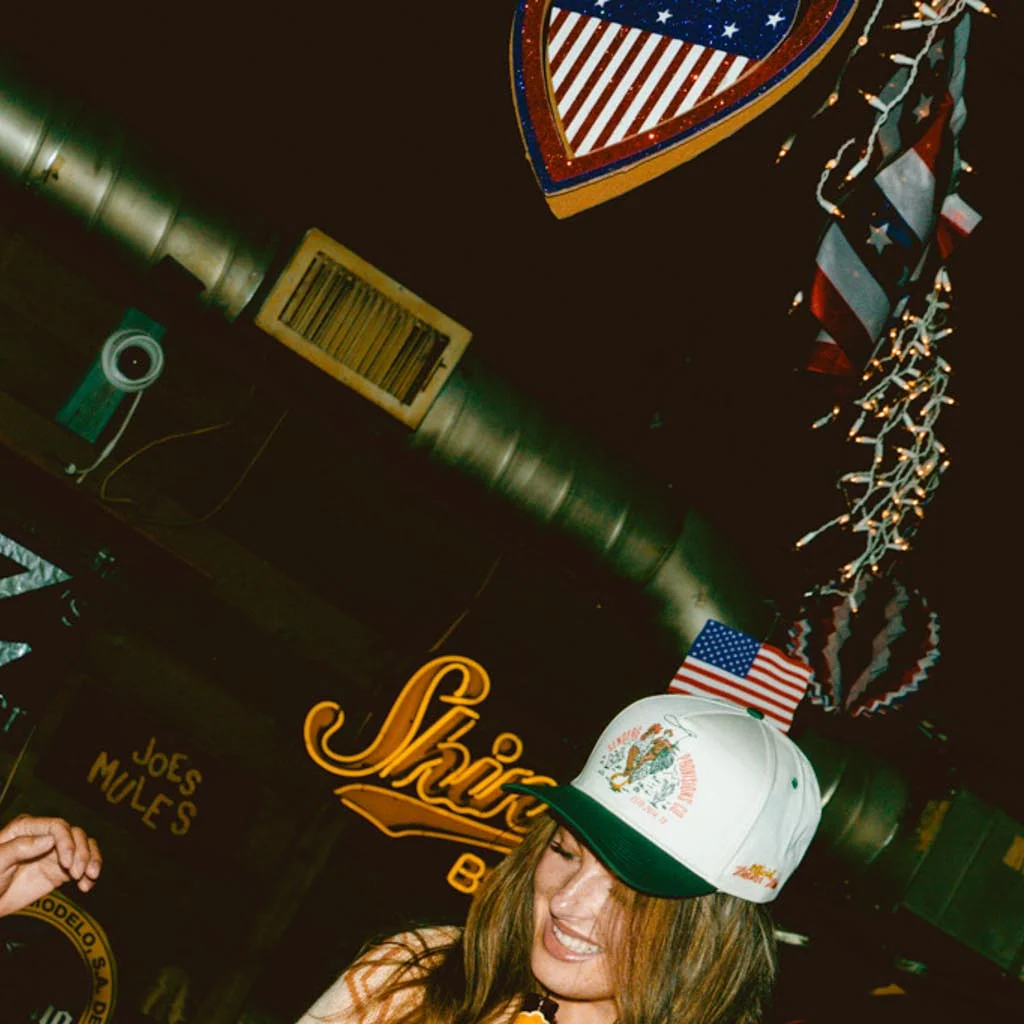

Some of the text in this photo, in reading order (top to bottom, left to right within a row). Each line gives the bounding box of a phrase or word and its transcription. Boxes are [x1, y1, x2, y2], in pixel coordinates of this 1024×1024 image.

[131, 736, 202, 797] JOES
[303, 655, 559, 833] Shin
[87, 751, 198, 836] MULES
